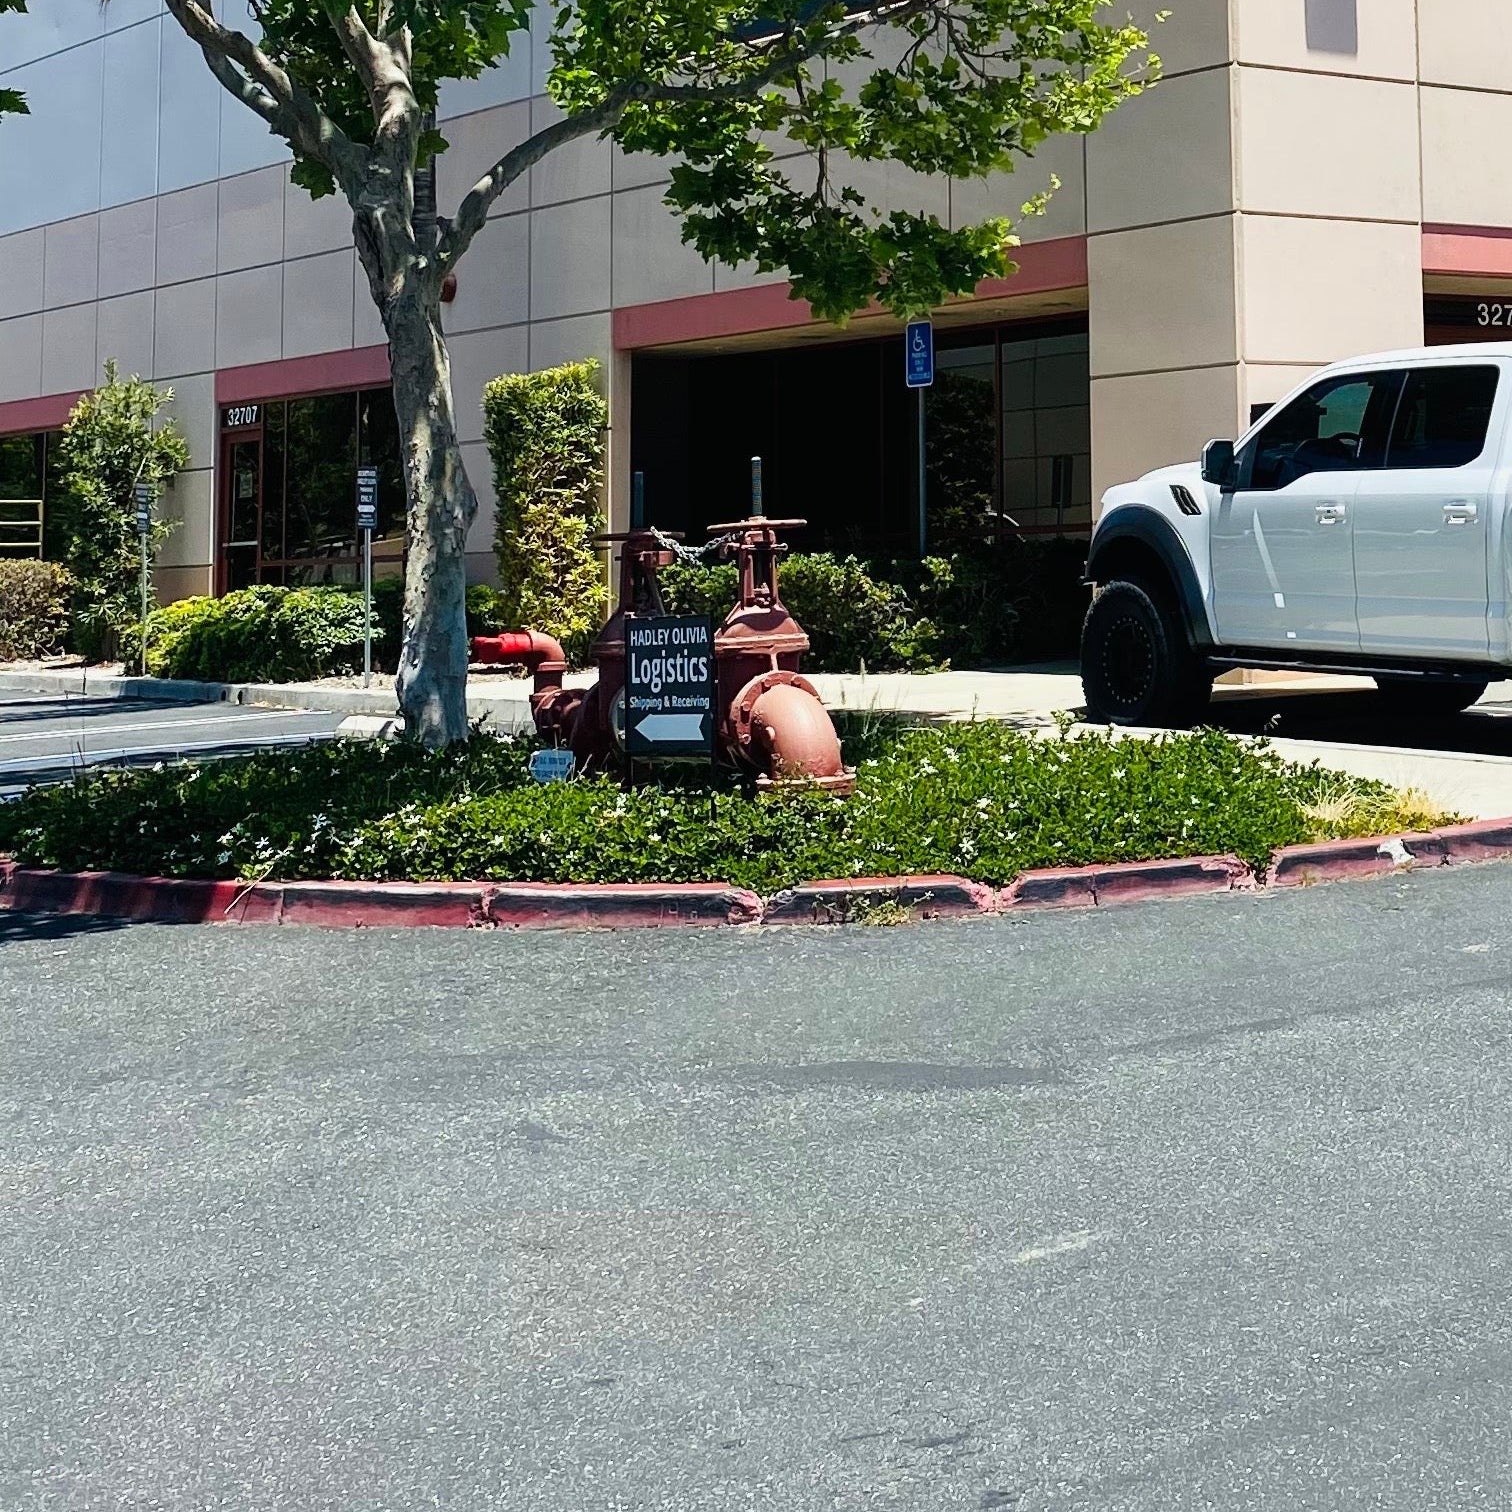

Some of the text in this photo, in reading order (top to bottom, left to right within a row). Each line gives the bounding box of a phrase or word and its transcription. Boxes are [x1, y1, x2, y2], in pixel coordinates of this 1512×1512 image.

[227, 405, 258, 426] 32707
[630, 626, 708, 647] HADLEY OLIVIA
[631, 648, 708, 694] Logistics
[629, 694, 710, 711] Shipping & Receiving
